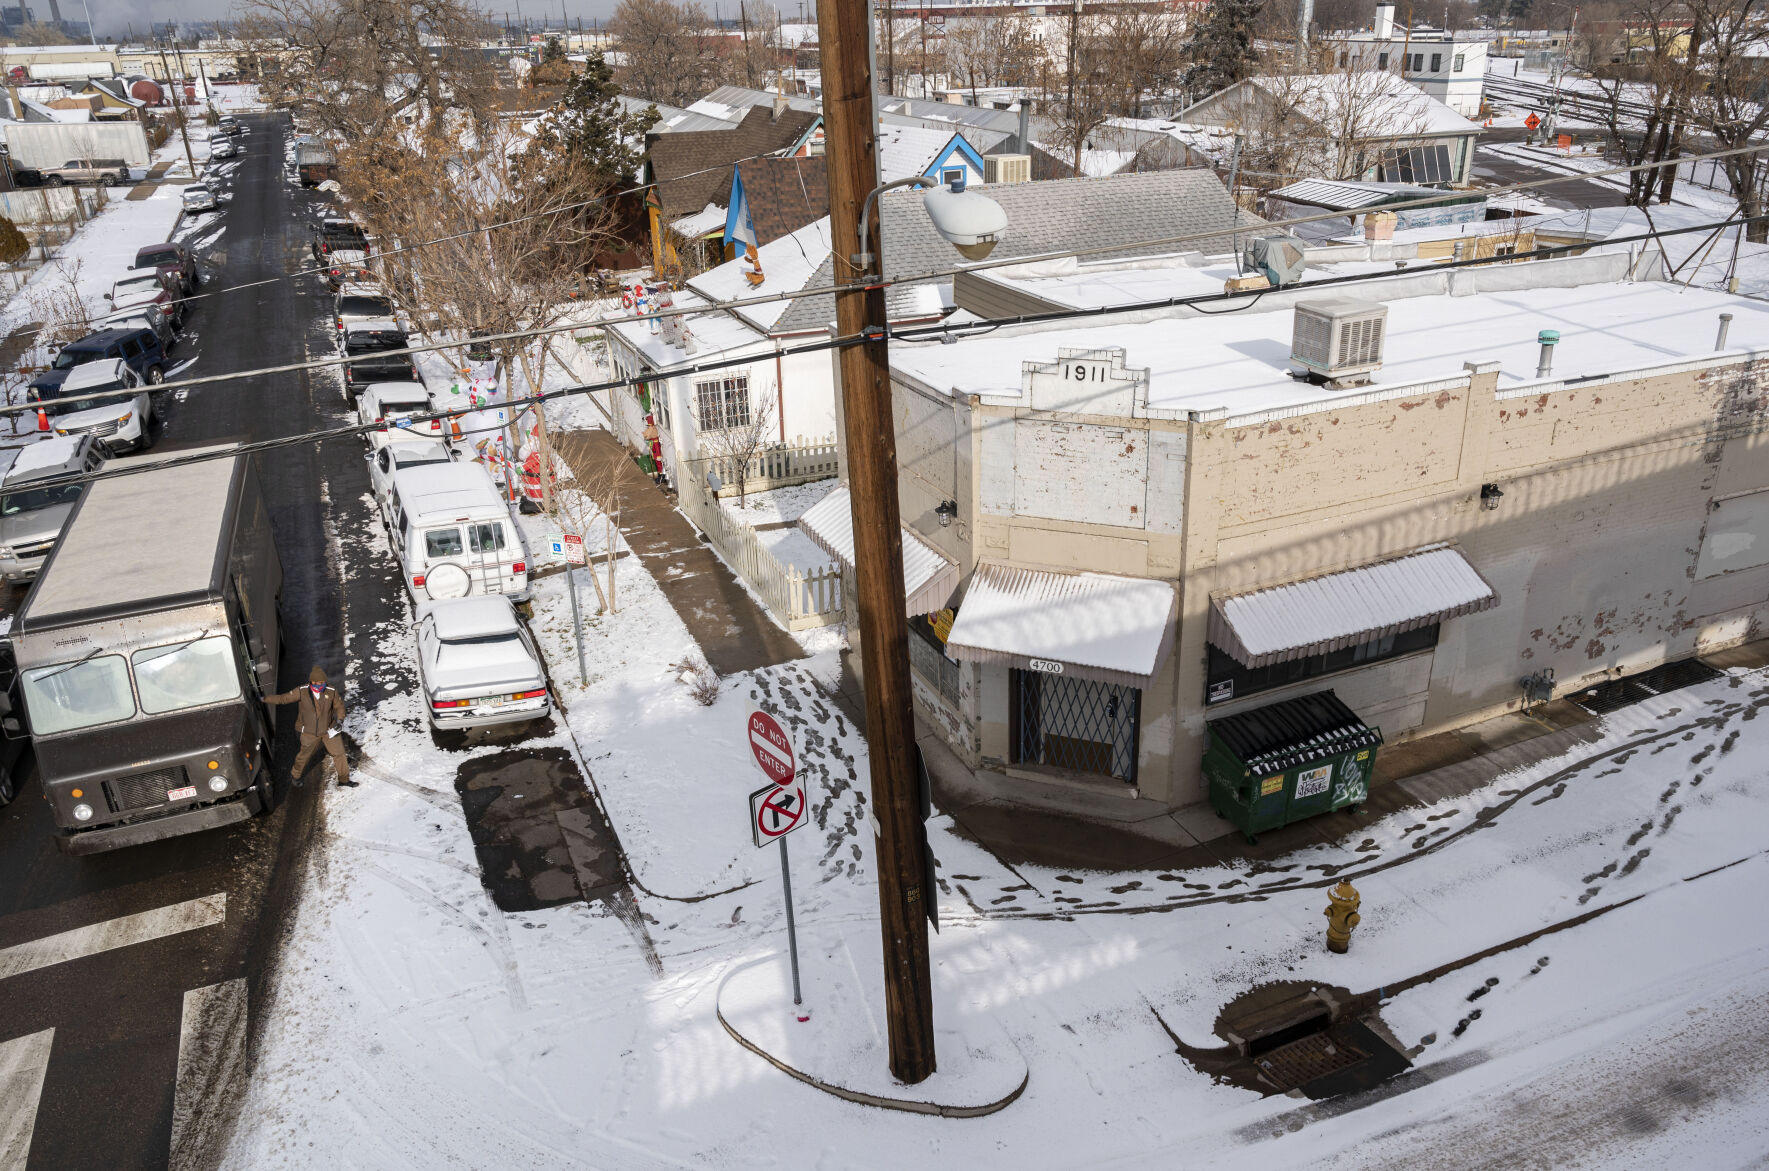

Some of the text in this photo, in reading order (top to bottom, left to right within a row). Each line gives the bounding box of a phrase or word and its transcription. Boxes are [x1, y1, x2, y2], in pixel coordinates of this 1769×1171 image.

[1065, 364, 1105, 383] 1911
[1032, 660, 1061, 673] 4700
[753, 717, 787, 749] DO NOT
[759, 750, 786, 777] ENTER
